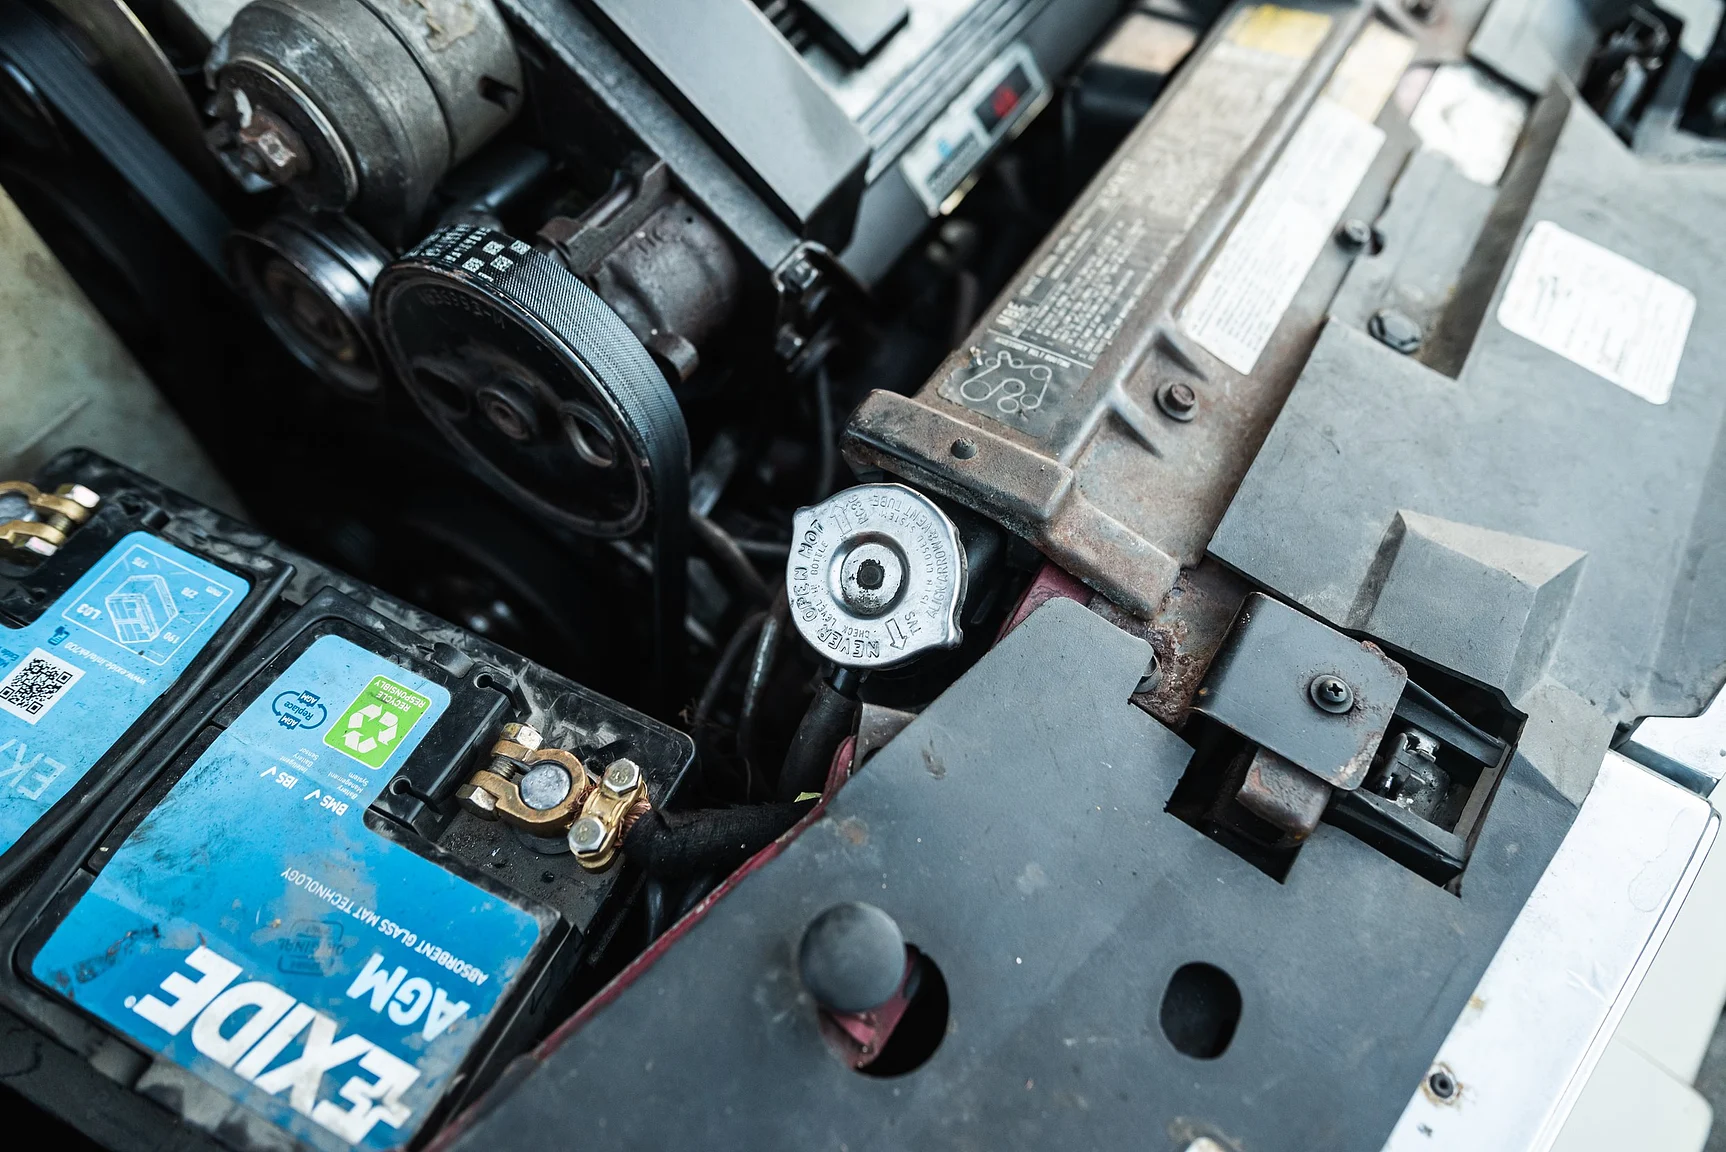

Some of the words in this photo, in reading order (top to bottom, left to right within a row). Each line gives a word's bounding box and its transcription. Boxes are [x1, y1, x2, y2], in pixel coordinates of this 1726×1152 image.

[798, 519, 824, 559] HOT
[810, 541, 828, 576] BOTTLE
[916, 535, 934, 573] CLOSED
[793, 567, 819, 622] OPEN
[927, 582, 945, 619] ALIGN
[815, 600, 837, 627] LEVEL
[905, 611, 922, 636] TVS
[163, 631, 180, 644] 190
[817, 624, 880, 658] NEVER
[842, 625, 870, 638] CHECK
[301, 692, 318, 704] AGM
[374, 679, 426, 709] RESPONSIBLY
[375, 690, 411, 712] RECYCLE
[281, 715, 298, 727] AGM
[284, 700, 314, 721] Replace
[279, 755, 309, 773] Intelligent
[292, 752, 313, 768] Battery
[299, 747, 319, 761] Sensor
[275, 771, 299, 790] IBS
[328, 771, 364, 794] Management
[348, 772, 369, 787] System
[336, 784, 358, 800] Battery
[319, 794, 349, 817] BMS
[281, 866, 356, 915] TECHNOLOGY
[352, 906, 381, 927] MAT
[378, 918, 418, 947] GLASS
[414, 939, 489, 986] ABSORBENT
[346, 952, 471, 1042] AGM
